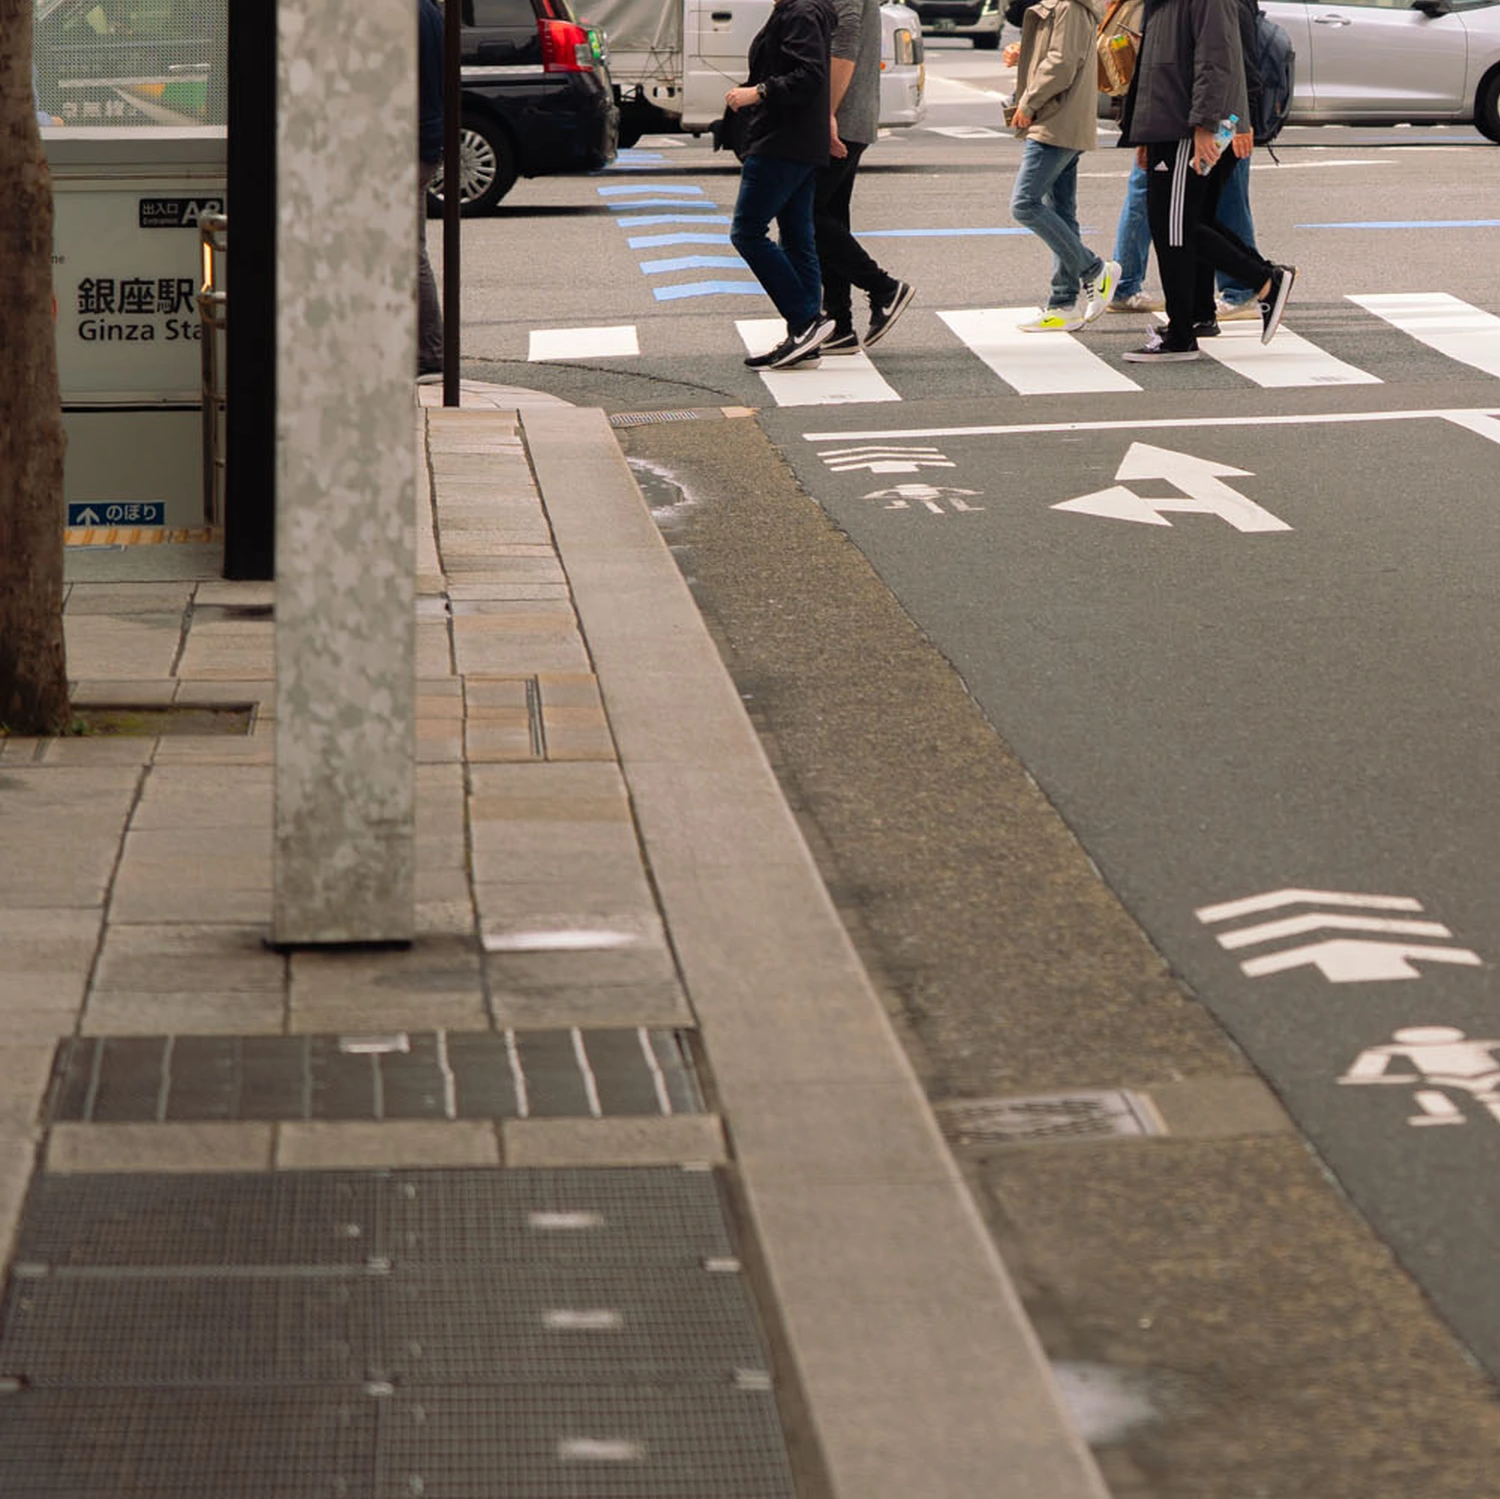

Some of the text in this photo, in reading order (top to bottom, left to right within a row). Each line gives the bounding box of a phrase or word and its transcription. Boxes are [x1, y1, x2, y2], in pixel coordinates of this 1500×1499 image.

[143, 202, 179, 215] 出入口
[78, 277, 194, 315] 銀座駅
[78, 318, 155, 342] Ginza
[106, 504, 156, 522] のぼり
